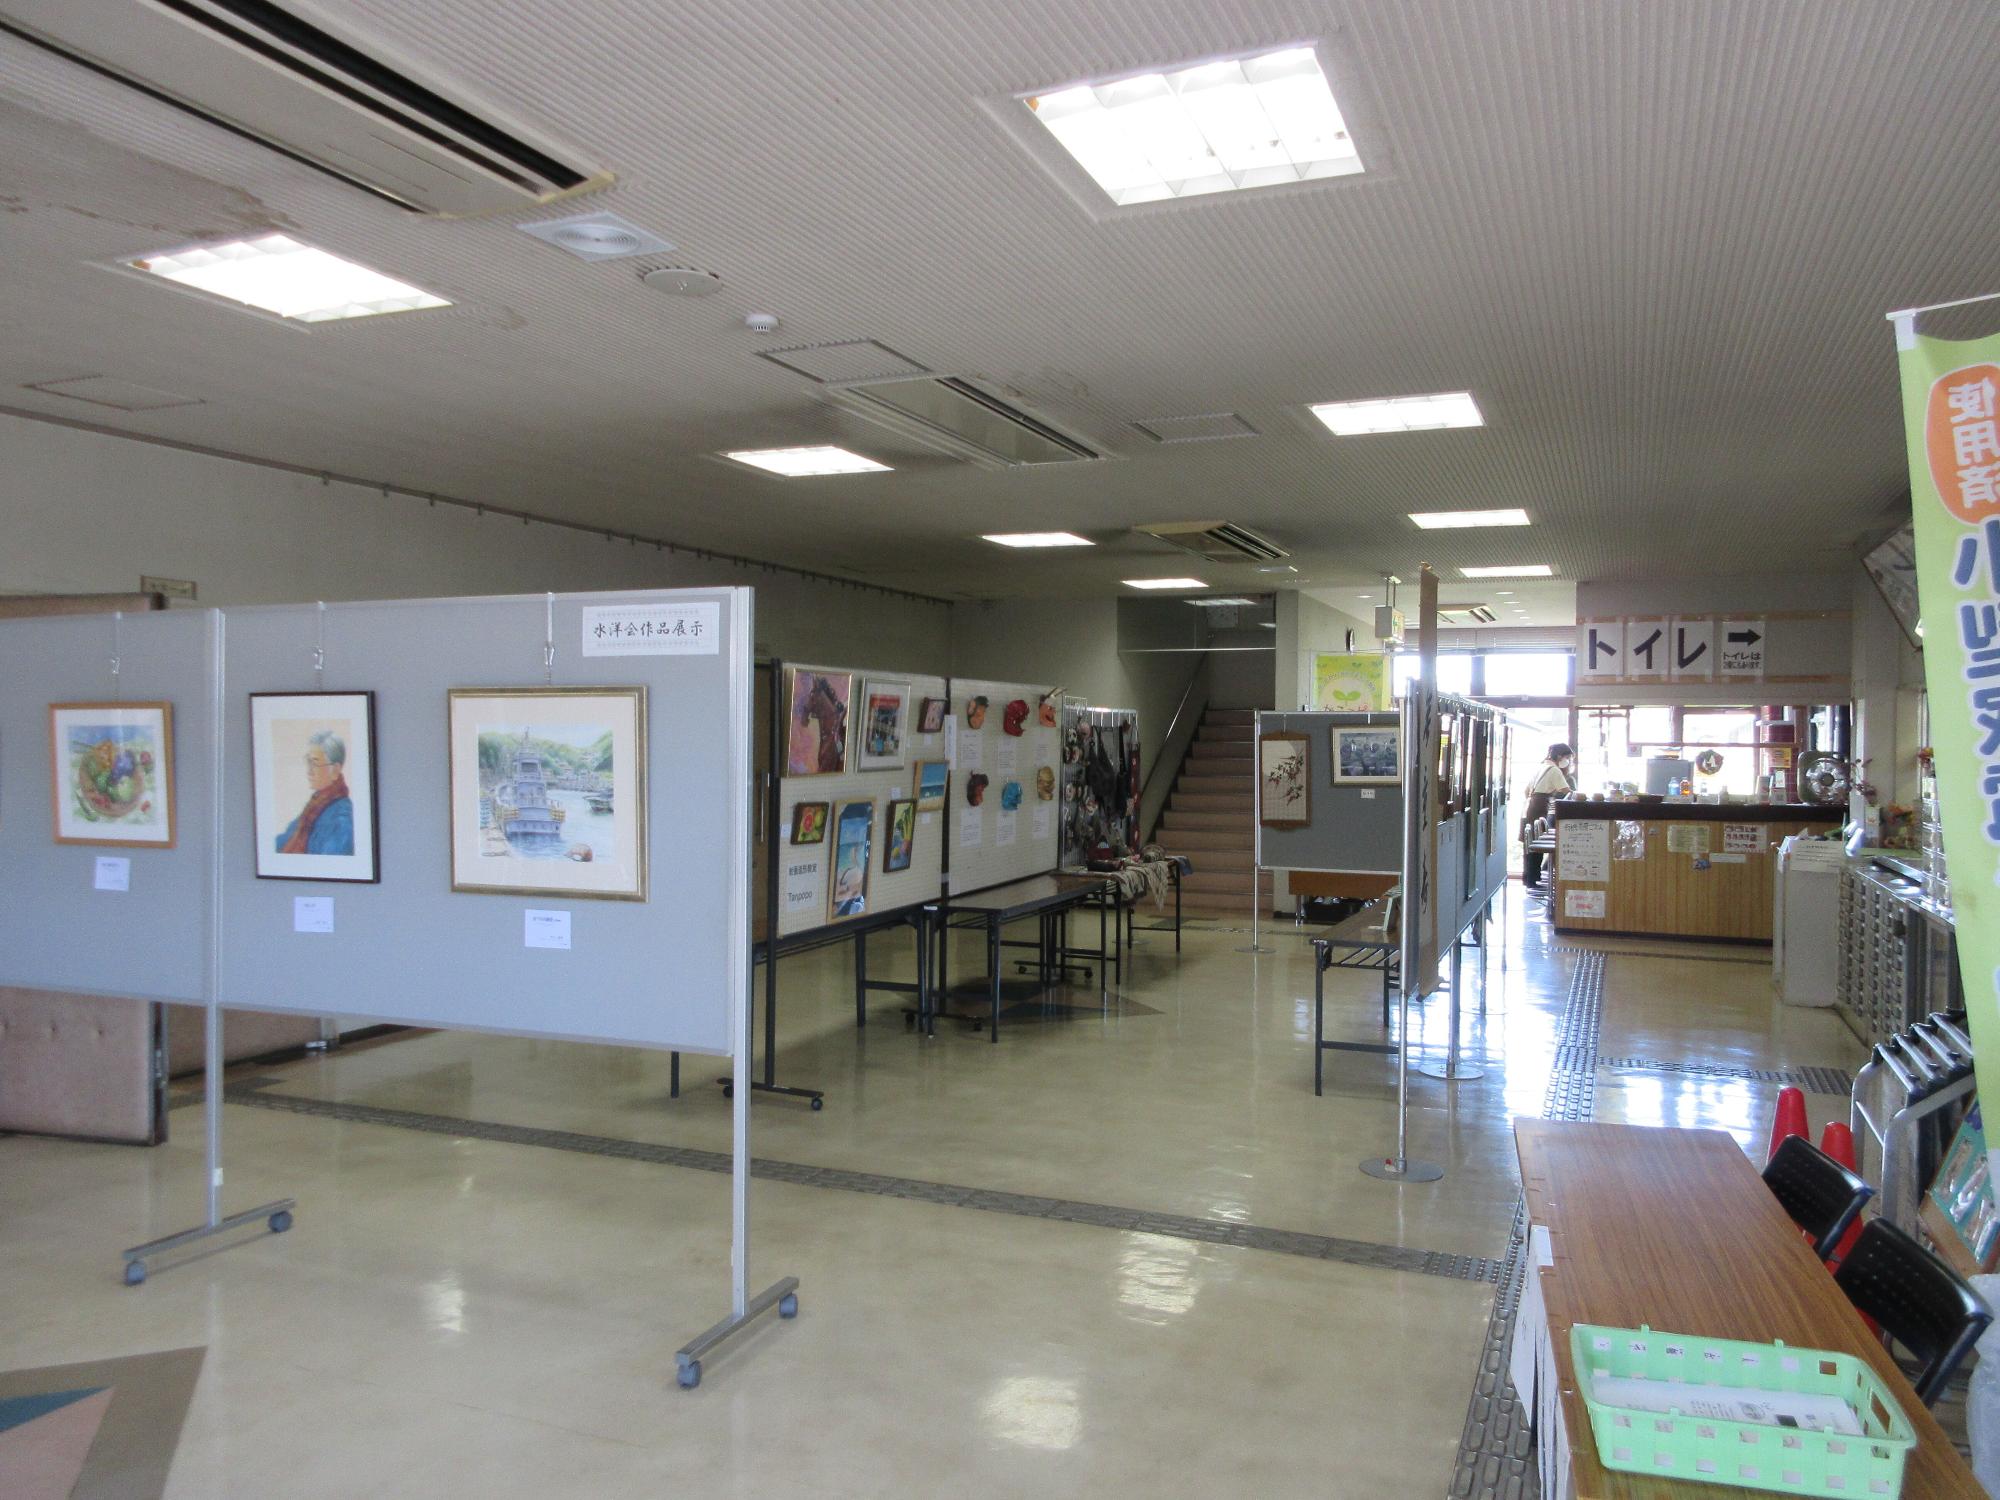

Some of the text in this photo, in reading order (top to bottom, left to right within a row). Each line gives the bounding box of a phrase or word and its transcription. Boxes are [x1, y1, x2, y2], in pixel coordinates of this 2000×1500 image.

[593, 619, 704, 638] 水洋会作品展示
[1588, 627, 1707, 670] トイレ
[1722, 651, 1762, 661] トイレは
[787, 890, 813, 903] Tanpopo
